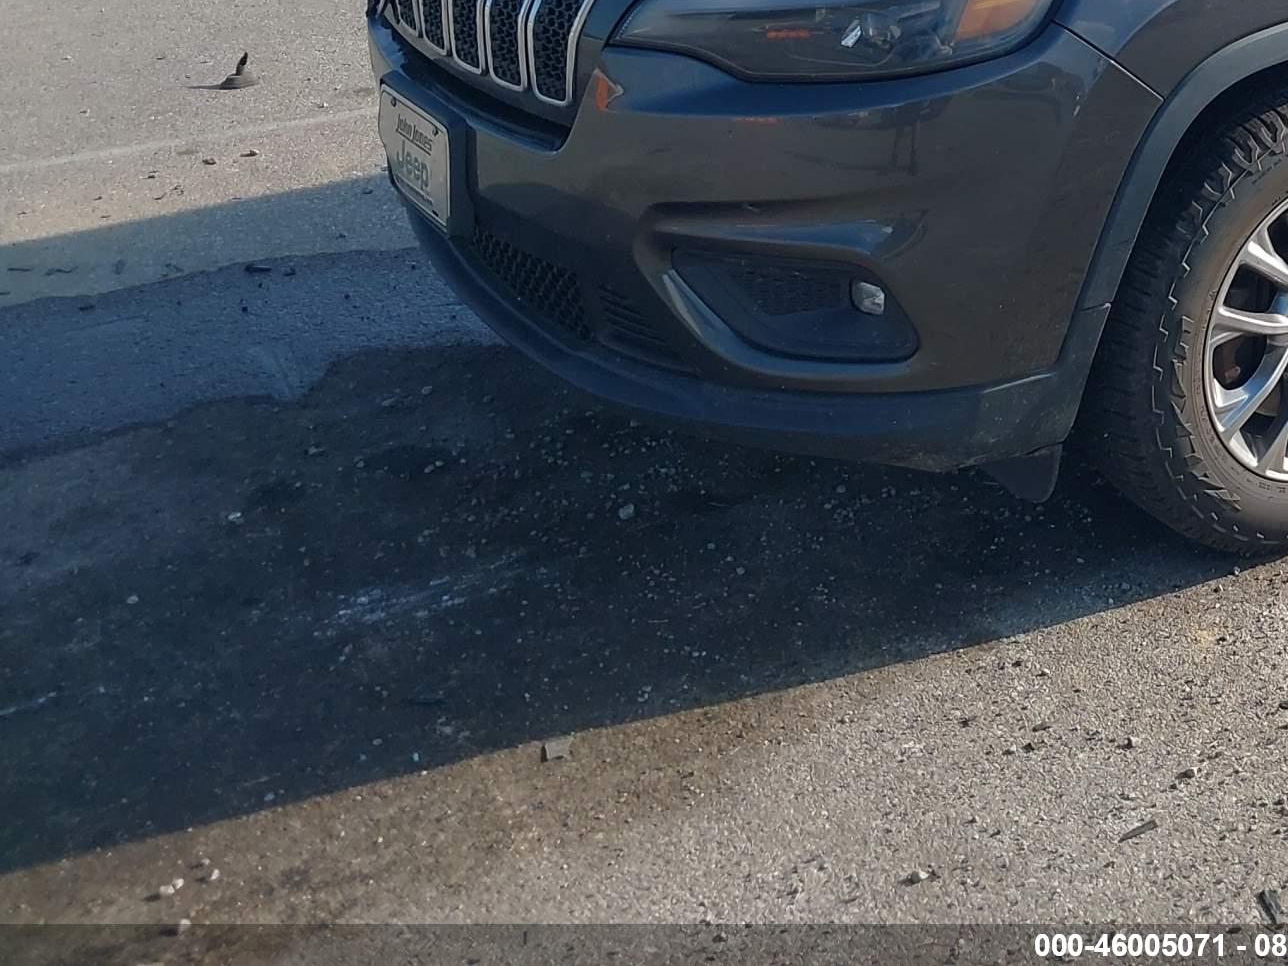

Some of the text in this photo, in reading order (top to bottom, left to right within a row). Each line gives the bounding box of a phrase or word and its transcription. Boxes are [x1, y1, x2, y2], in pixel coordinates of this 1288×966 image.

[396, 114, 433, 152] John Jones
[397, 140, 430, 190] Jeep
